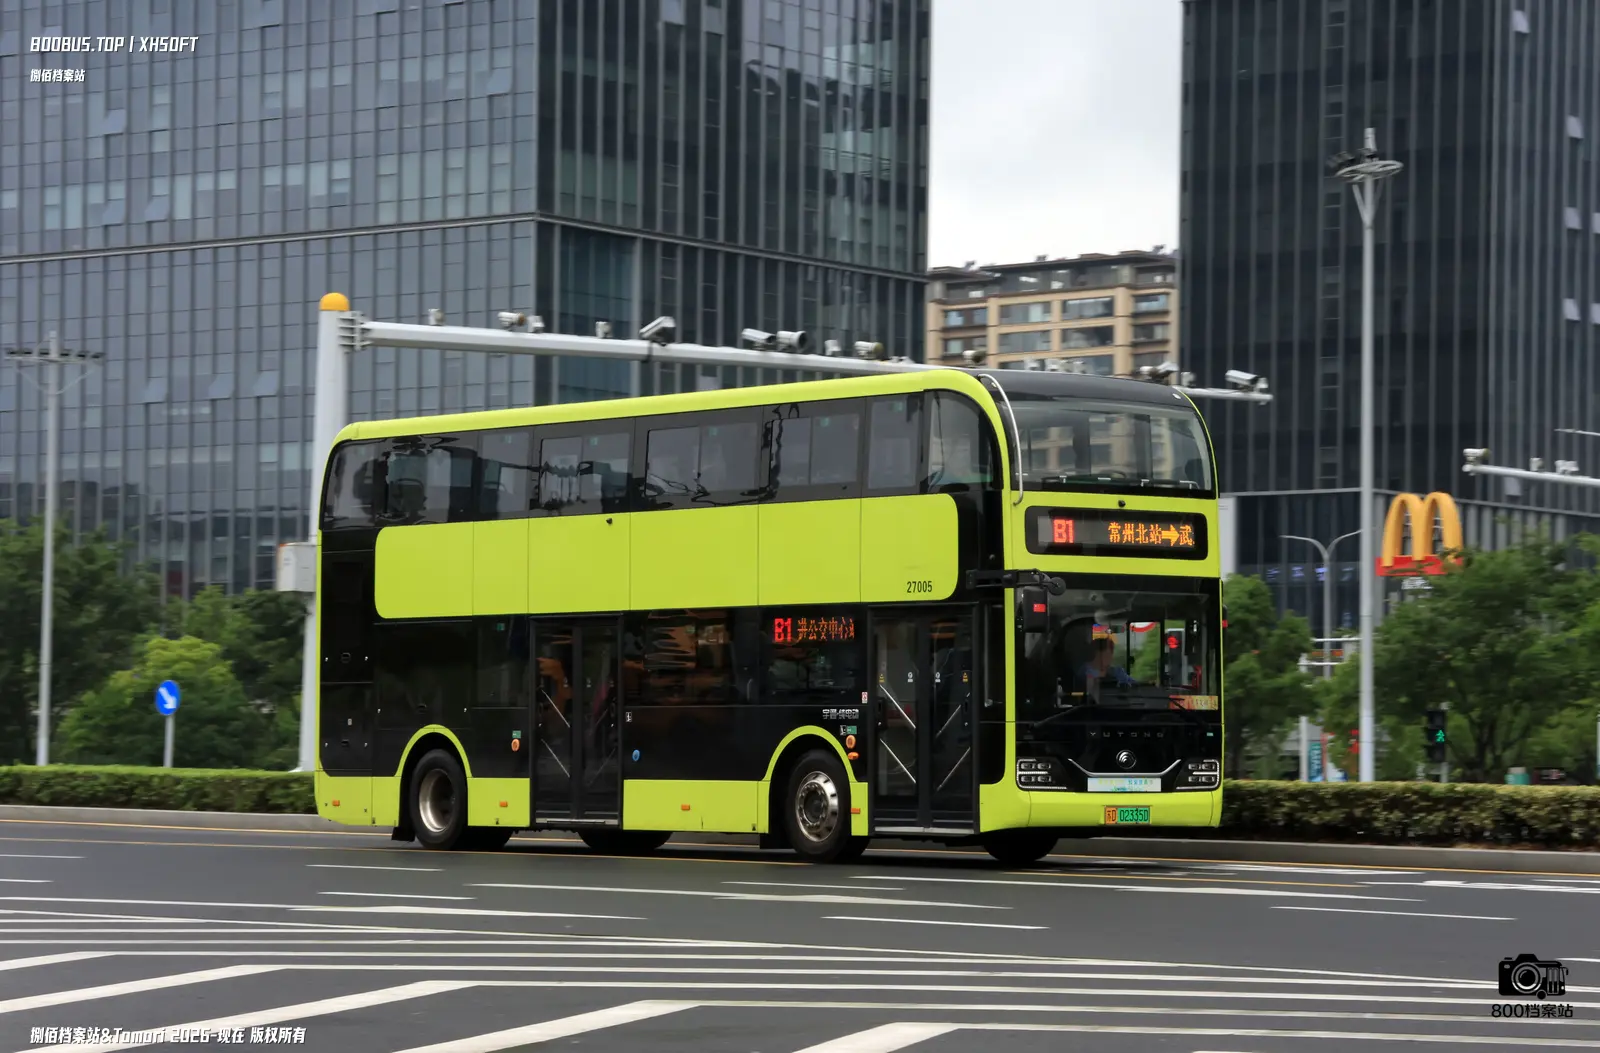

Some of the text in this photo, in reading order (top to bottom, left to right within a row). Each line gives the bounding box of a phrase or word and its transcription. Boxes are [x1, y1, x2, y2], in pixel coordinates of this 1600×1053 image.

[1053, 519, 1074, 544] B1
[907, 580, 933, 593] 27005
[774, 617, 792, 642] B1
